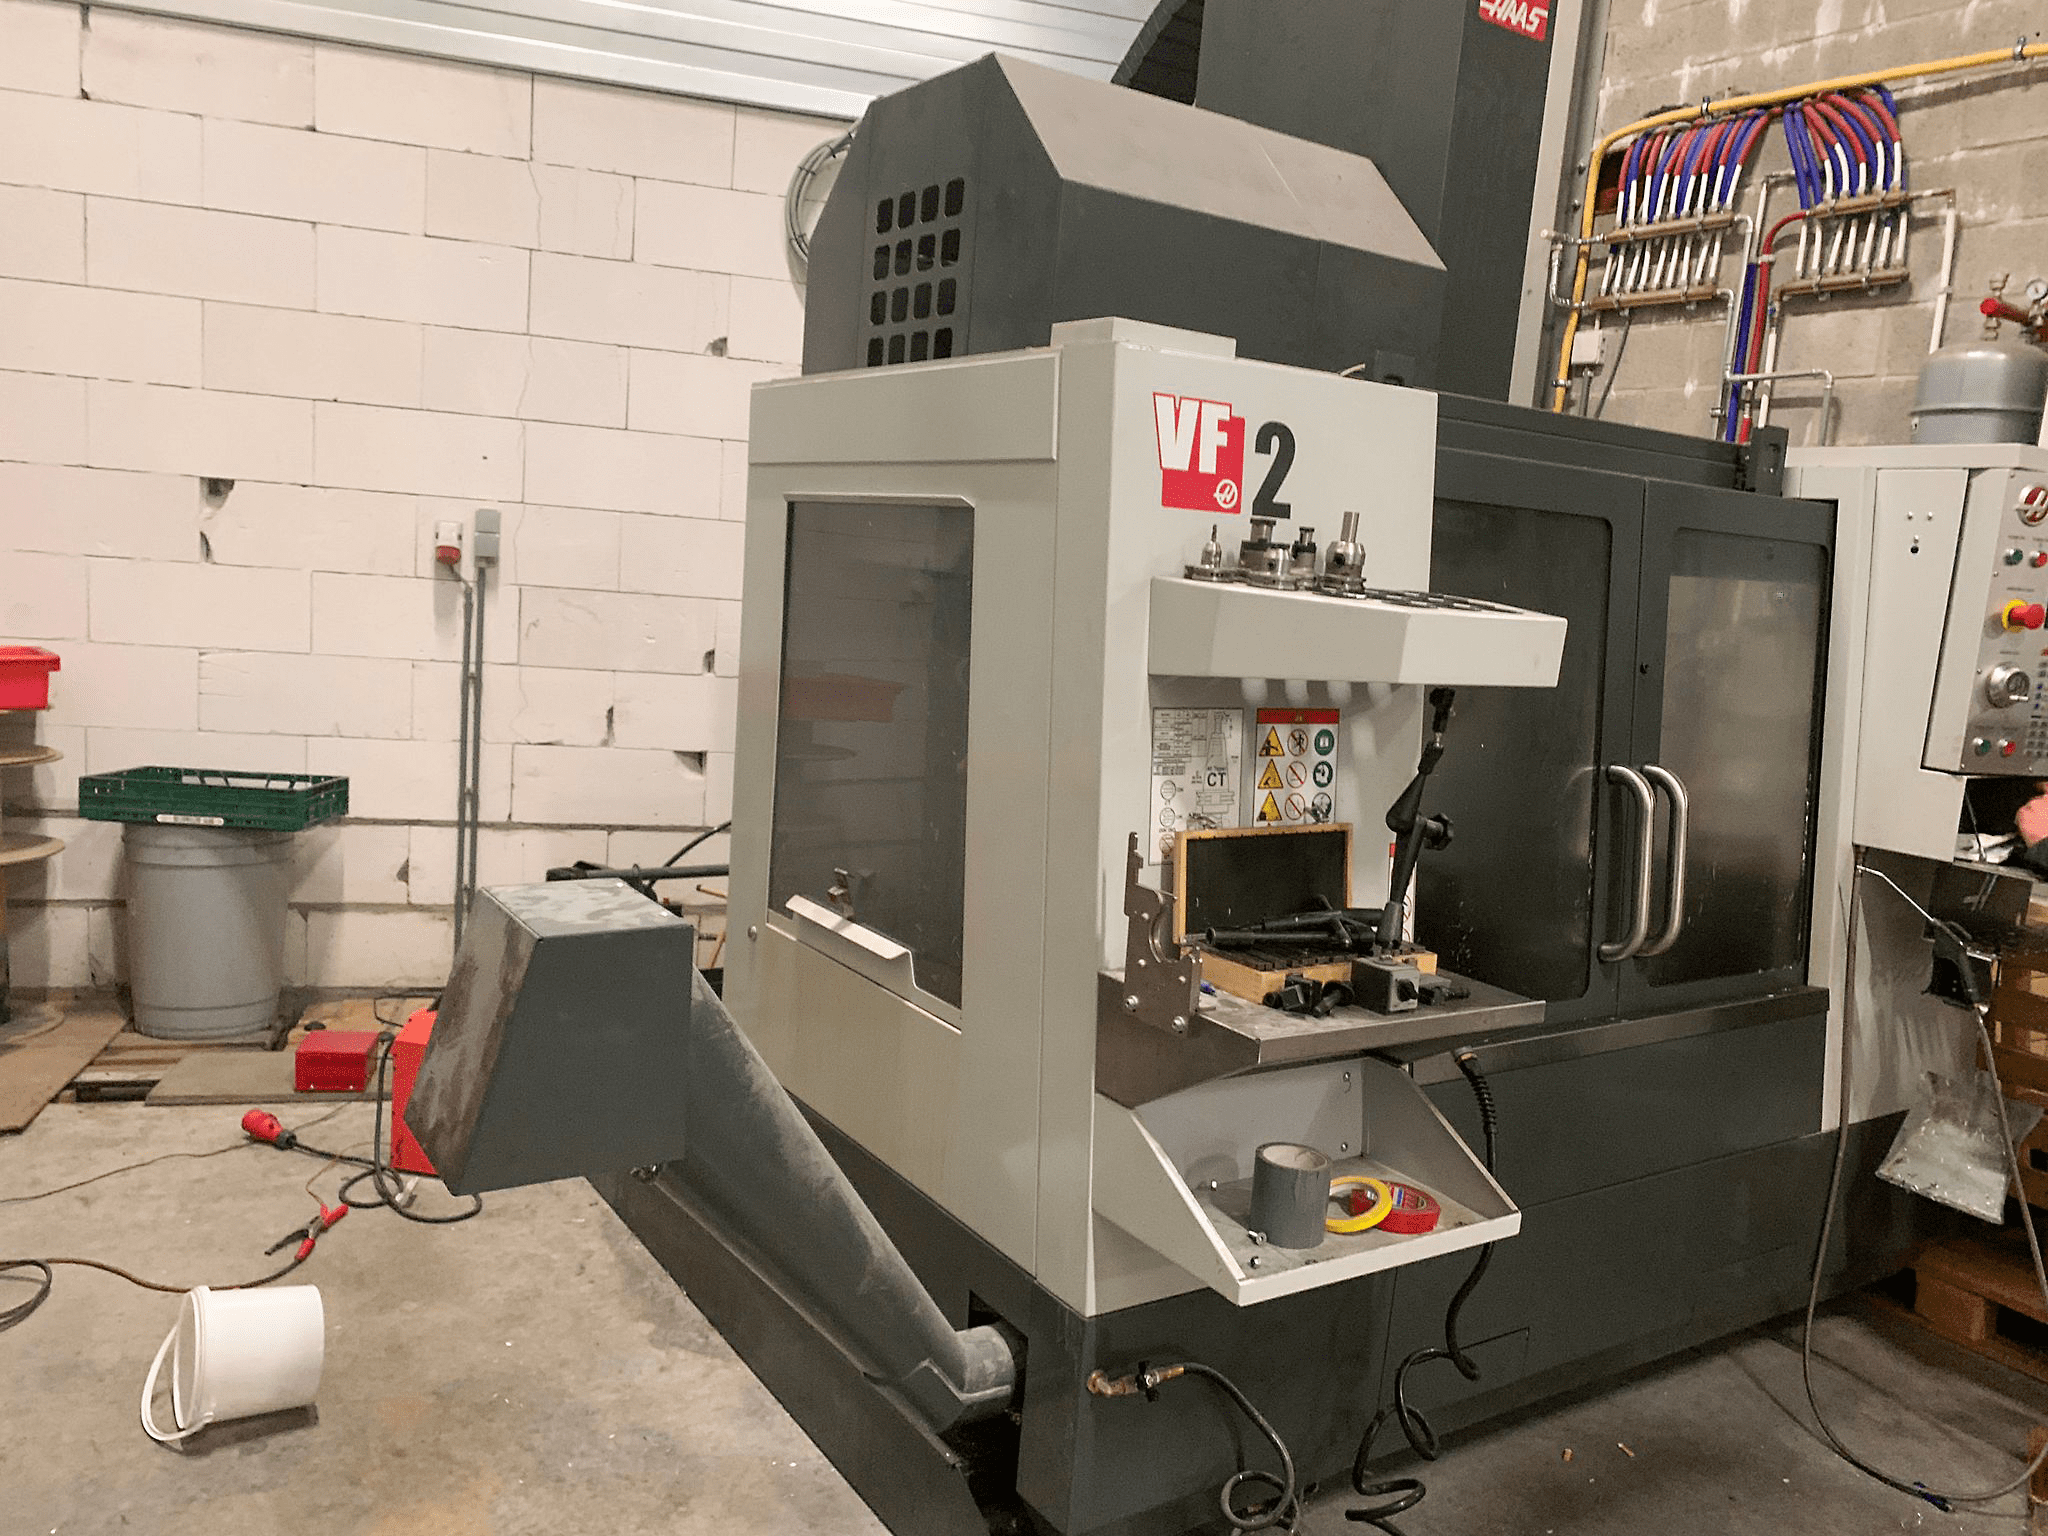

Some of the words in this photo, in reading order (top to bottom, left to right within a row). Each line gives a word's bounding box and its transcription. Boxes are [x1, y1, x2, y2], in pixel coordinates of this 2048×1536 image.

[1480, 0, 1548, 32] HAAS
[1153, 392, 1232, 475] VF
[1252, 421, 1296, 519] 2
[1207, 772, 1226, 787] CT
